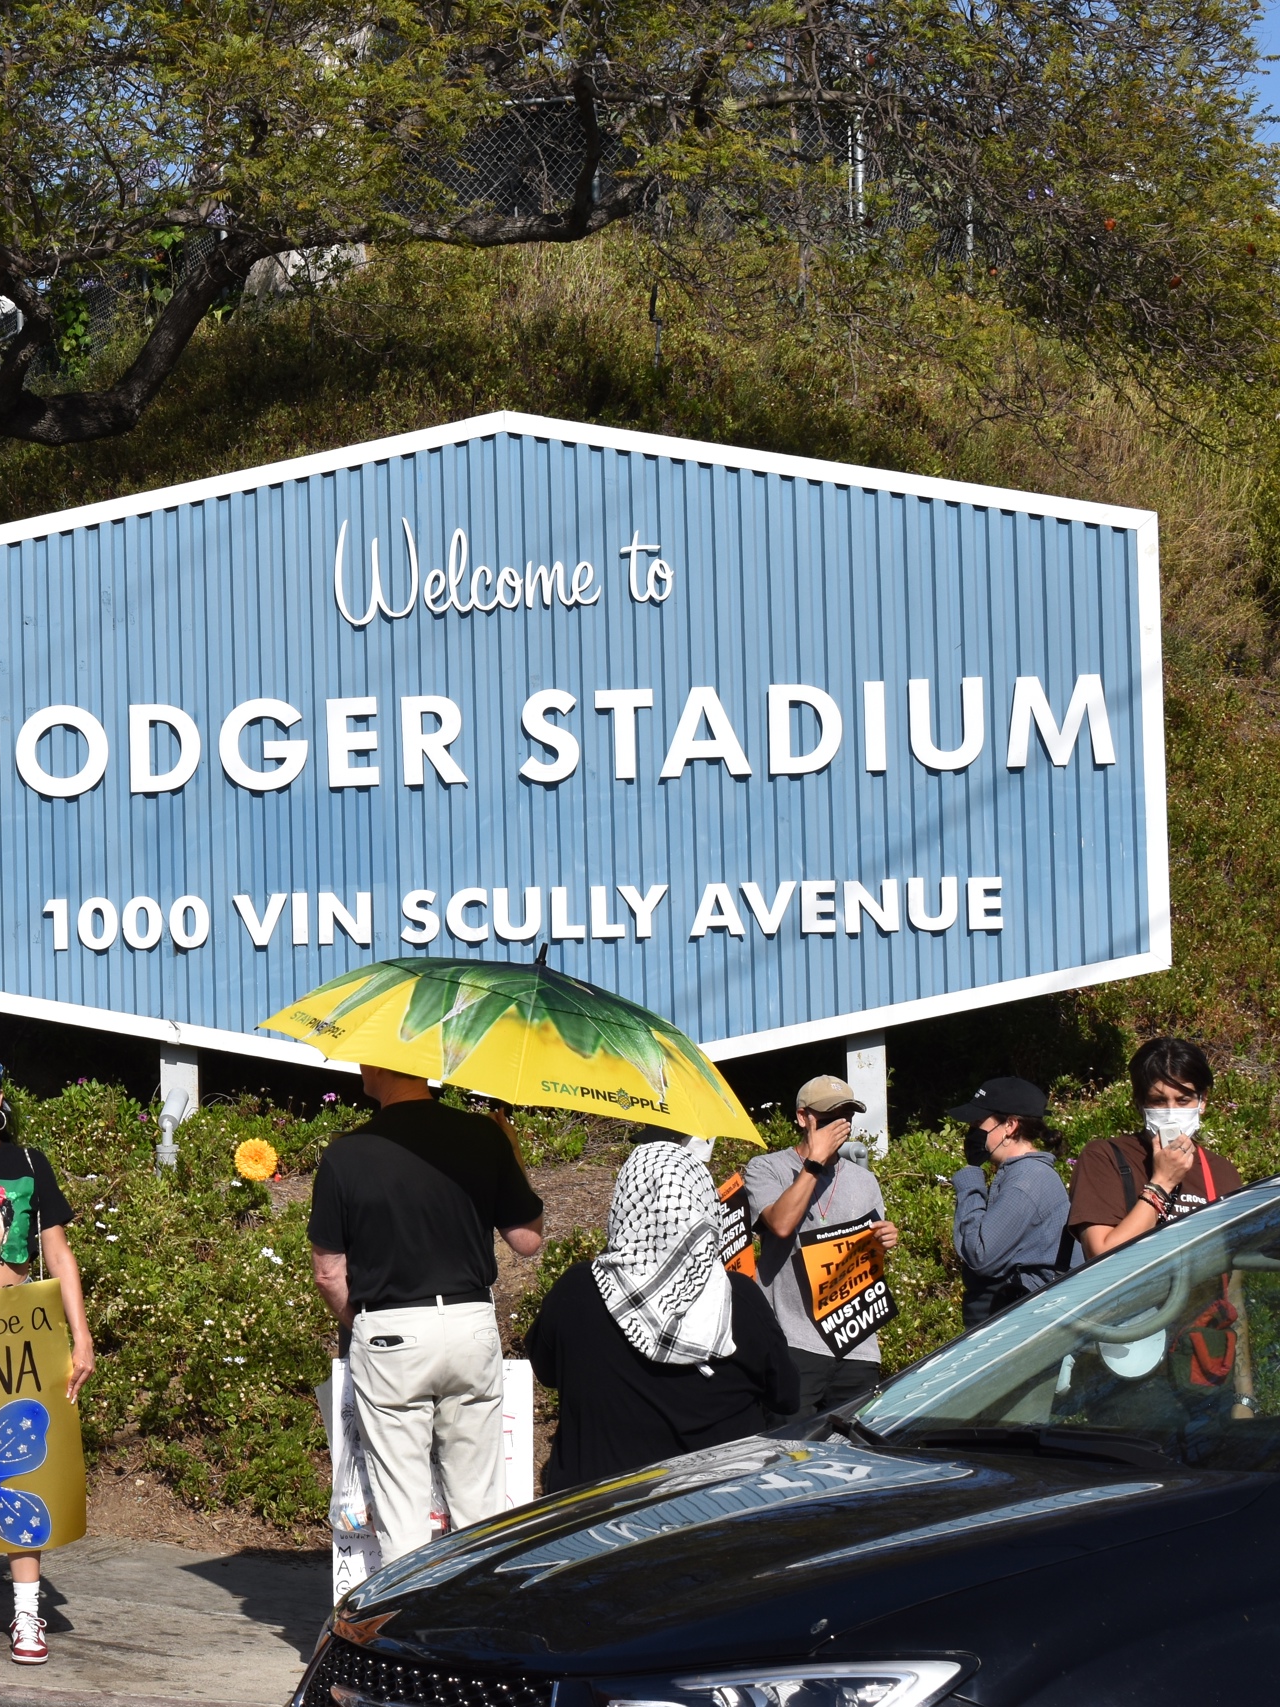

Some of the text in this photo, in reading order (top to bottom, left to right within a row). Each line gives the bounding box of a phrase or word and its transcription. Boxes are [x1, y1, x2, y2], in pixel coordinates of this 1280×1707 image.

[335, 516, 674, 627] Welcome to
[518, 673, 1117, 784] STADIUM
[42, 876, 1003, 952] 1000 VIN SCULLY AVENUE
[723, 1206, 745, 1229] IMEN
[722, 1234, 748, 1263] TRUMP
[31, 1306, 53, 1331] a
[821, 1281, 886, 1334] MUST GO
[834, 1296, 889, 1349] NOW!!!
